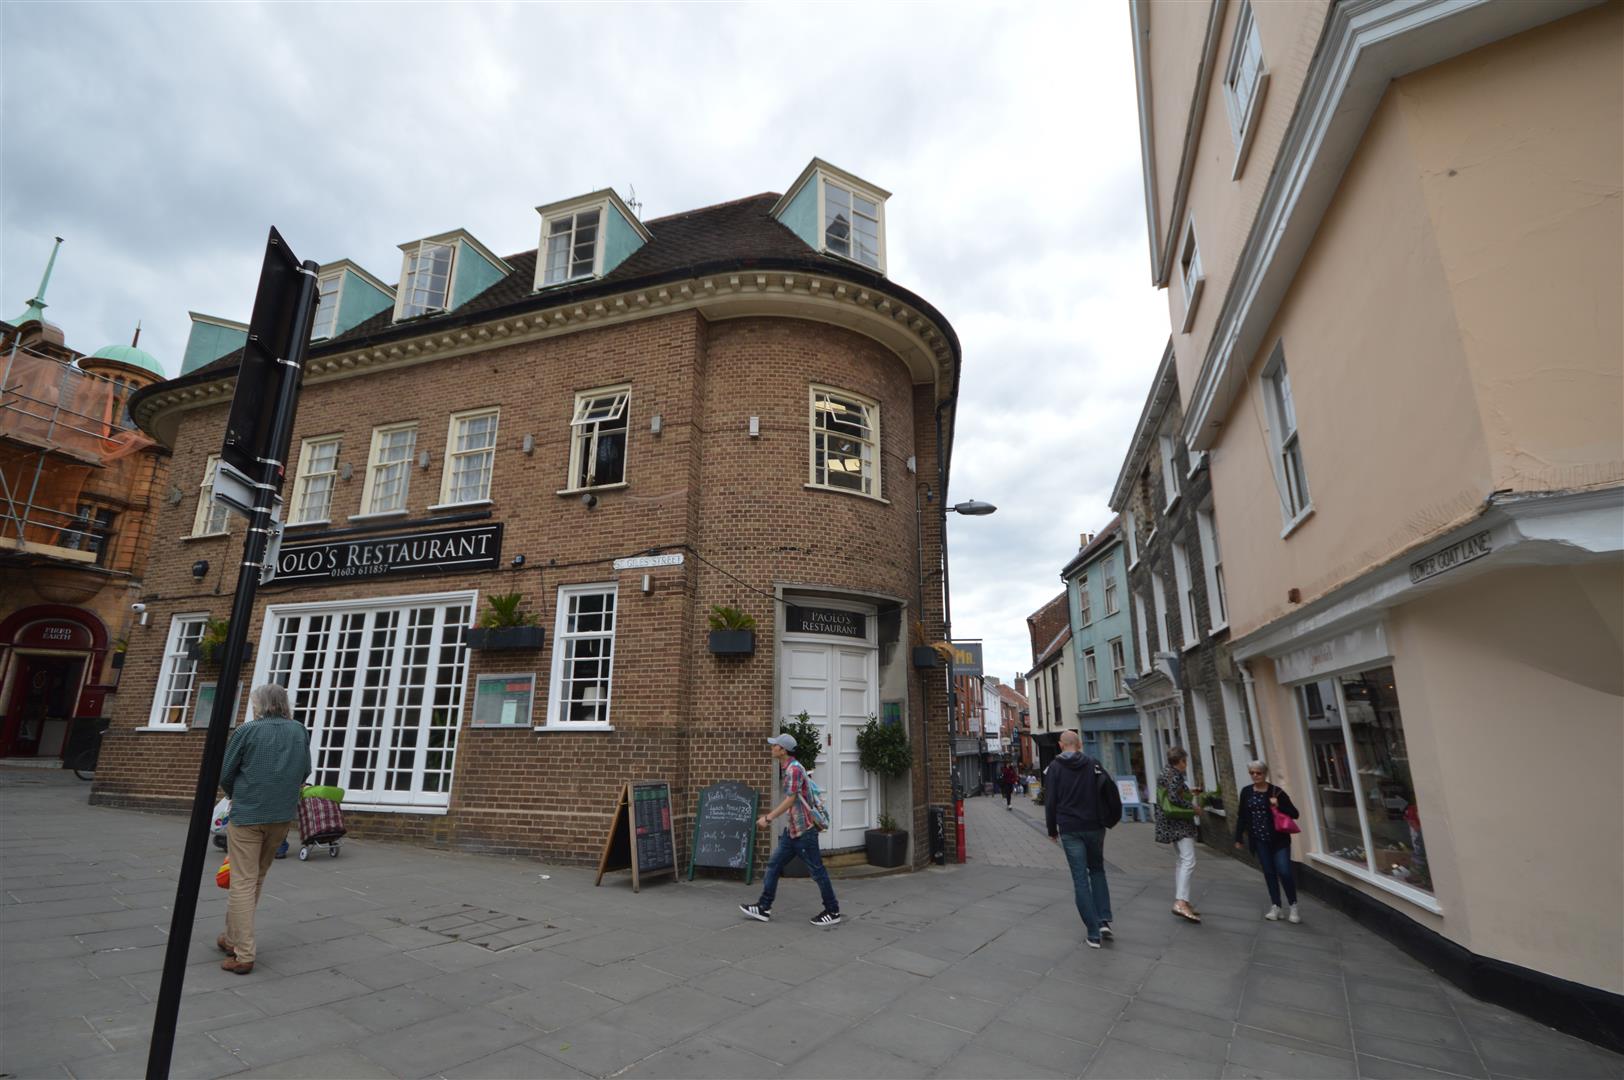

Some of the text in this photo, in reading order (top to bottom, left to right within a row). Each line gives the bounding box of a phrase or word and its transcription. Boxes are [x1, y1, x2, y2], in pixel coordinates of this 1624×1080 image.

[1462, 533, 1490, 560] LANE
[276, 534, 492, 573] OLO'S RESTAURANT
[652, 555, 681, 566] STREET
[331, 564, 389, 577] 01603 611857
[812, 611, 851, 624] PAOLO'S
[802, 620, 857, 634] RESTAURANT
